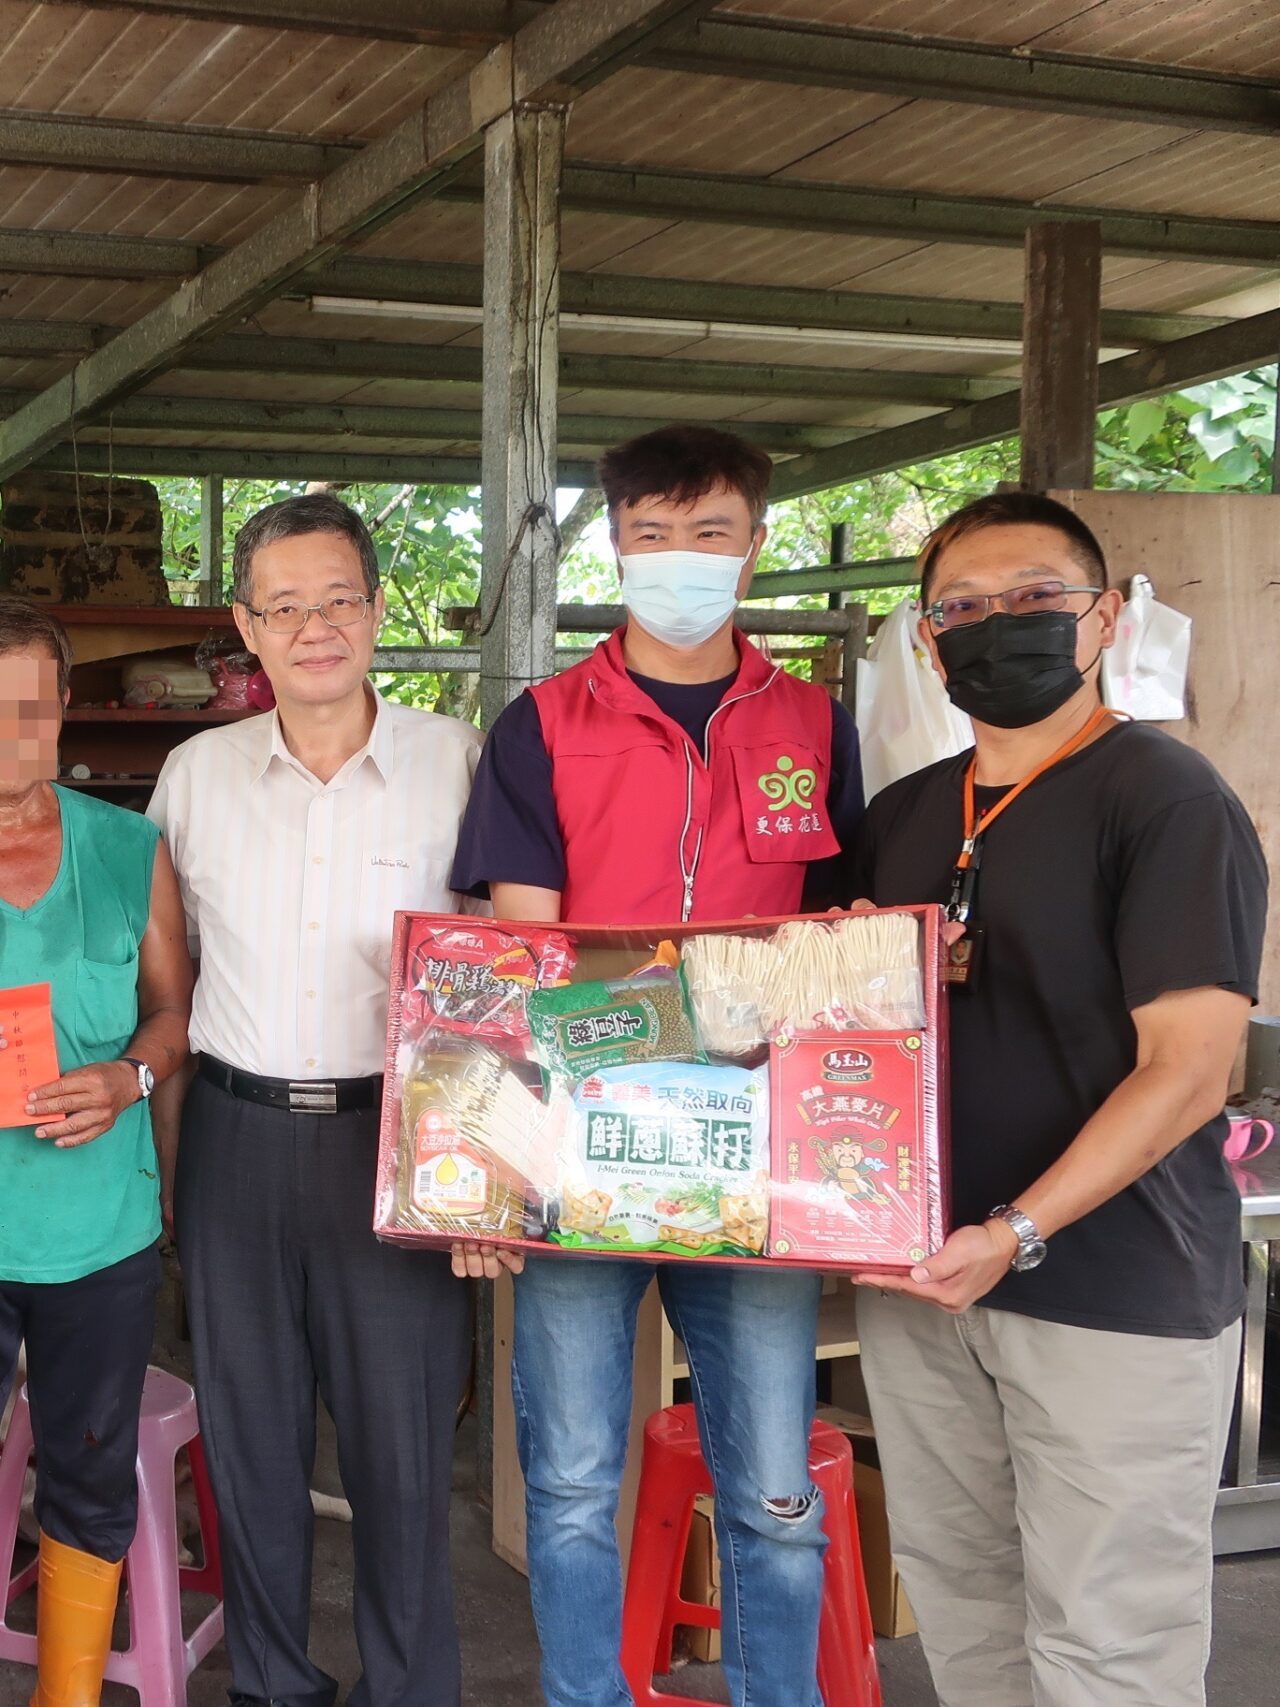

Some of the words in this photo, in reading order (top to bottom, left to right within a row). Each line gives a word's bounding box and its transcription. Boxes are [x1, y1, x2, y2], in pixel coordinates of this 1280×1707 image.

[828, 1052, 869, 1069] 馬玉山
[658, 1086, 753, 1114] 天然取向
[812, 1096, 885, 1120] 大燕麥片
[621, 1166, 646, 1176] Green
[649, 1168, 676, 1179] Onion
[678, 1170, 700, 1181] Soda
